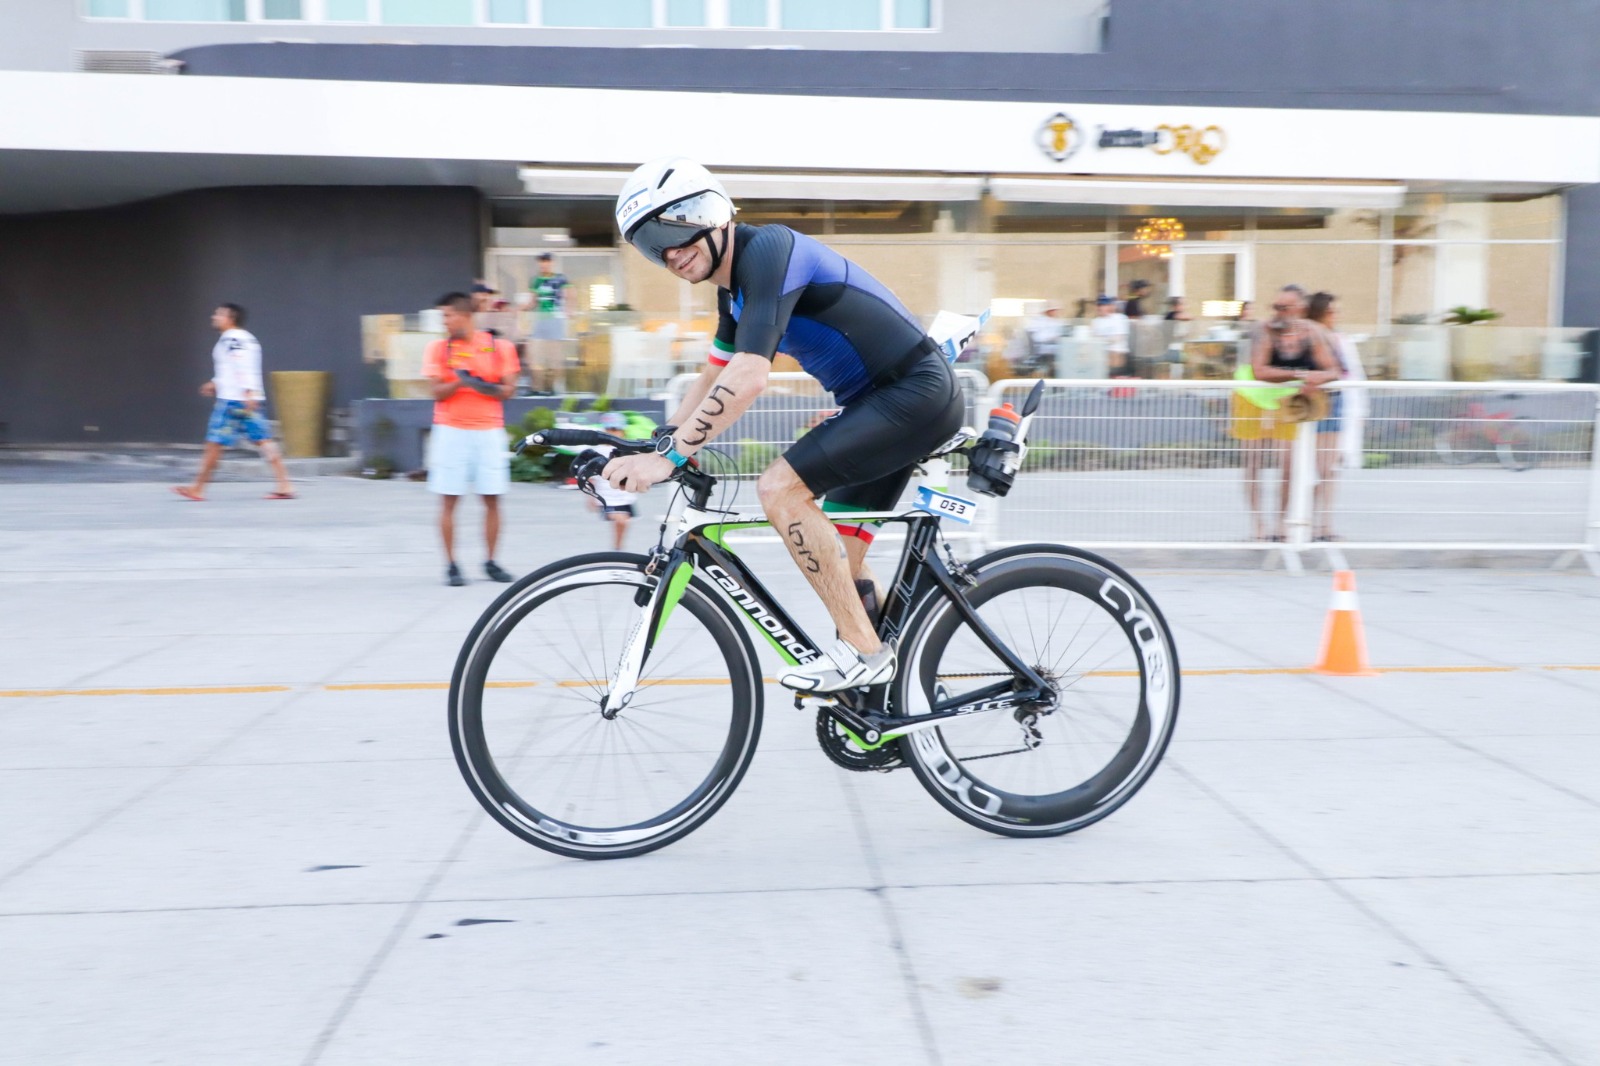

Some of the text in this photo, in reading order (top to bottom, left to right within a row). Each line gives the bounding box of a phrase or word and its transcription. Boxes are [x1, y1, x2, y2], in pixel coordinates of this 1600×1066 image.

[622, 200, 639, 218] 053
[682, 384, 736, 446] 53
[939, 499, 966, 515] 053
[788, 521, 821, 574] 53
[705, 564, 820, 665] cannonda
